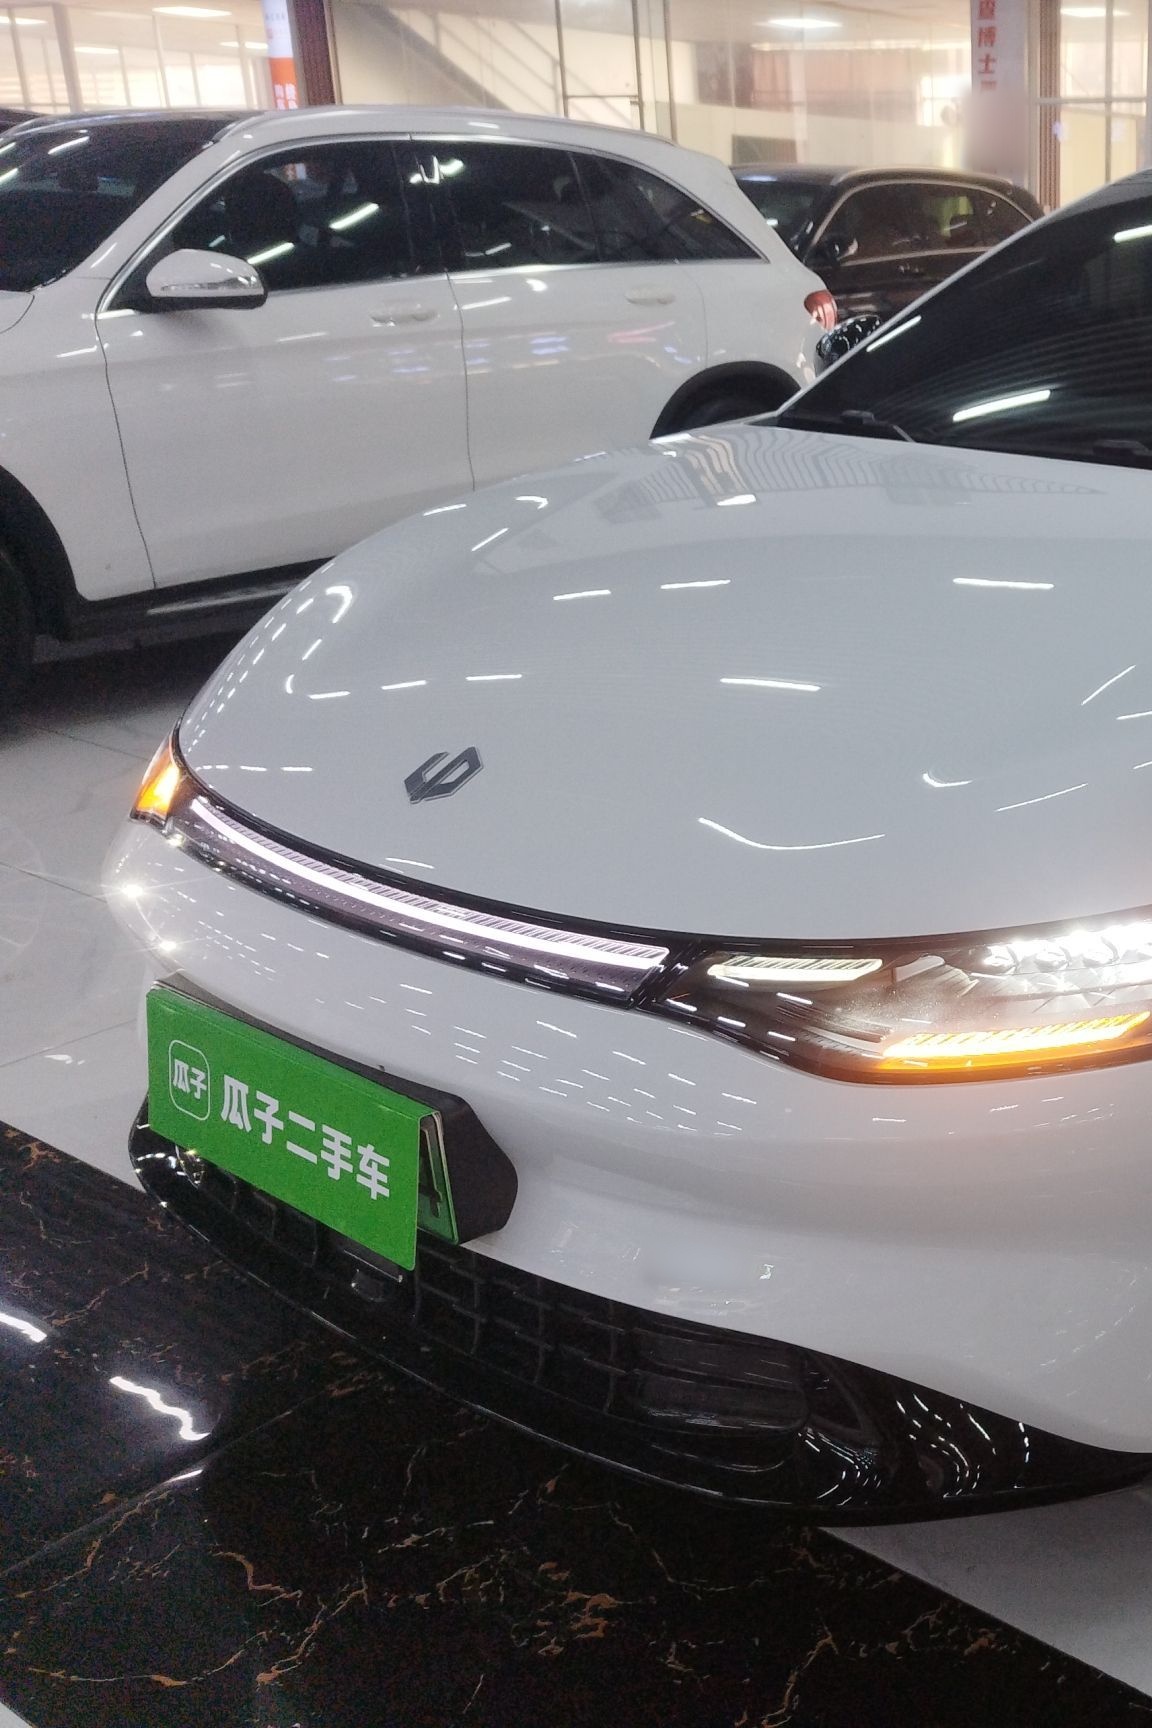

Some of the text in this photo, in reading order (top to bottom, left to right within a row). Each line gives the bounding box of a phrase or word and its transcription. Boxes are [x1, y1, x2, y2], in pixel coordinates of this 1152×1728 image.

[173, 1059, 208, 1099] 瓜子
[221, 1075, 390, 1200] 瓜子二手车
